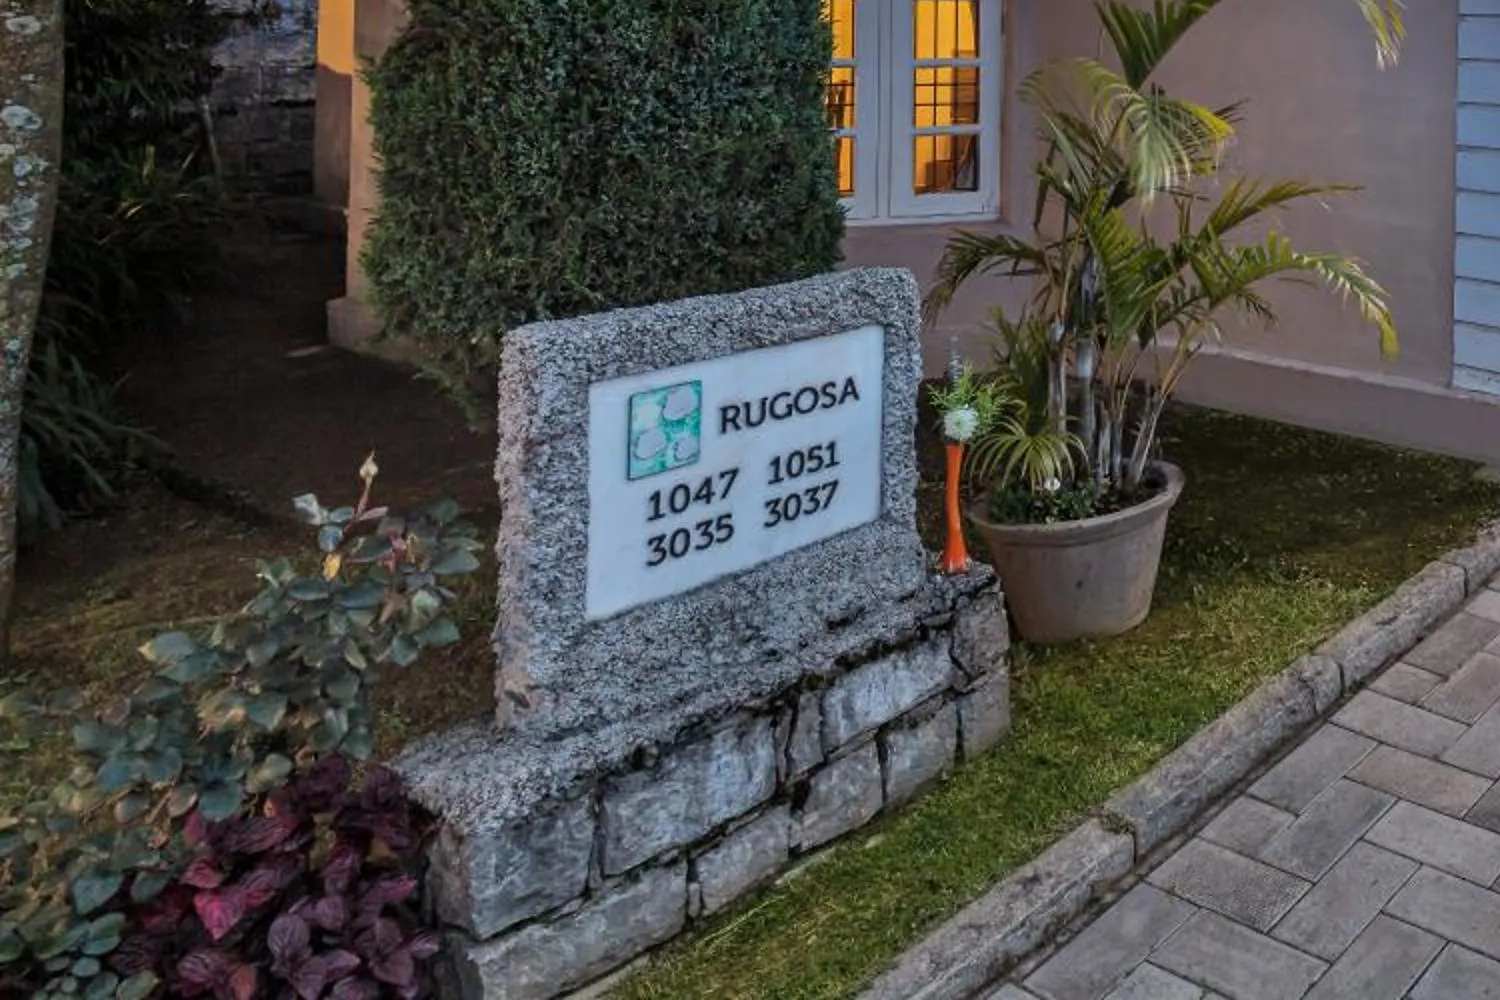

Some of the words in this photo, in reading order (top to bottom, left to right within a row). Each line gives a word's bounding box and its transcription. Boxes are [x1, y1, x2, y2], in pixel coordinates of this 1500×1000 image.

[718, 375, 861, 435] RUGOSA
[645, 466, 741, 523] 1047
[766, 440, 841, 486] 1051
[645, 511, 736, 568] 3035
[763, 478, 841, 529] 3037
